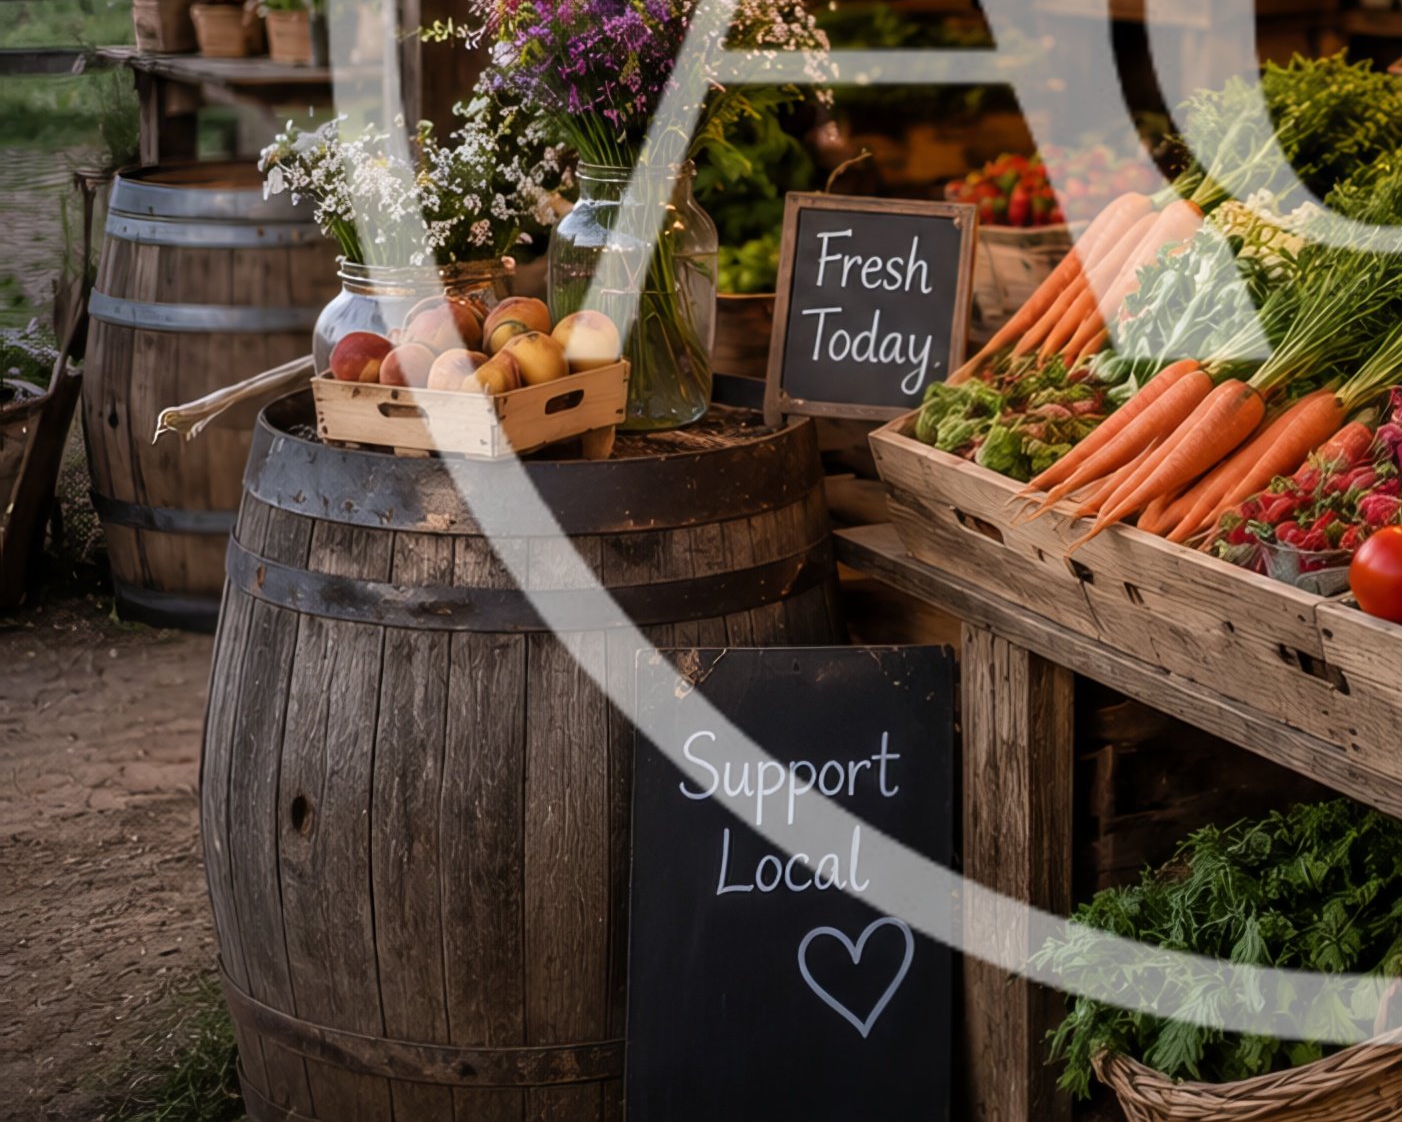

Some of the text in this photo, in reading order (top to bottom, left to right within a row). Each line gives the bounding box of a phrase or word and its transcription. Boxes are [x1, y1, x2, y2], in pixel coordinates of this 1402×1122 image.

[816, 228, 932, 294] Fresh
[679, 730, 901, 825] Support
[716, 824, 870, 896] Local
